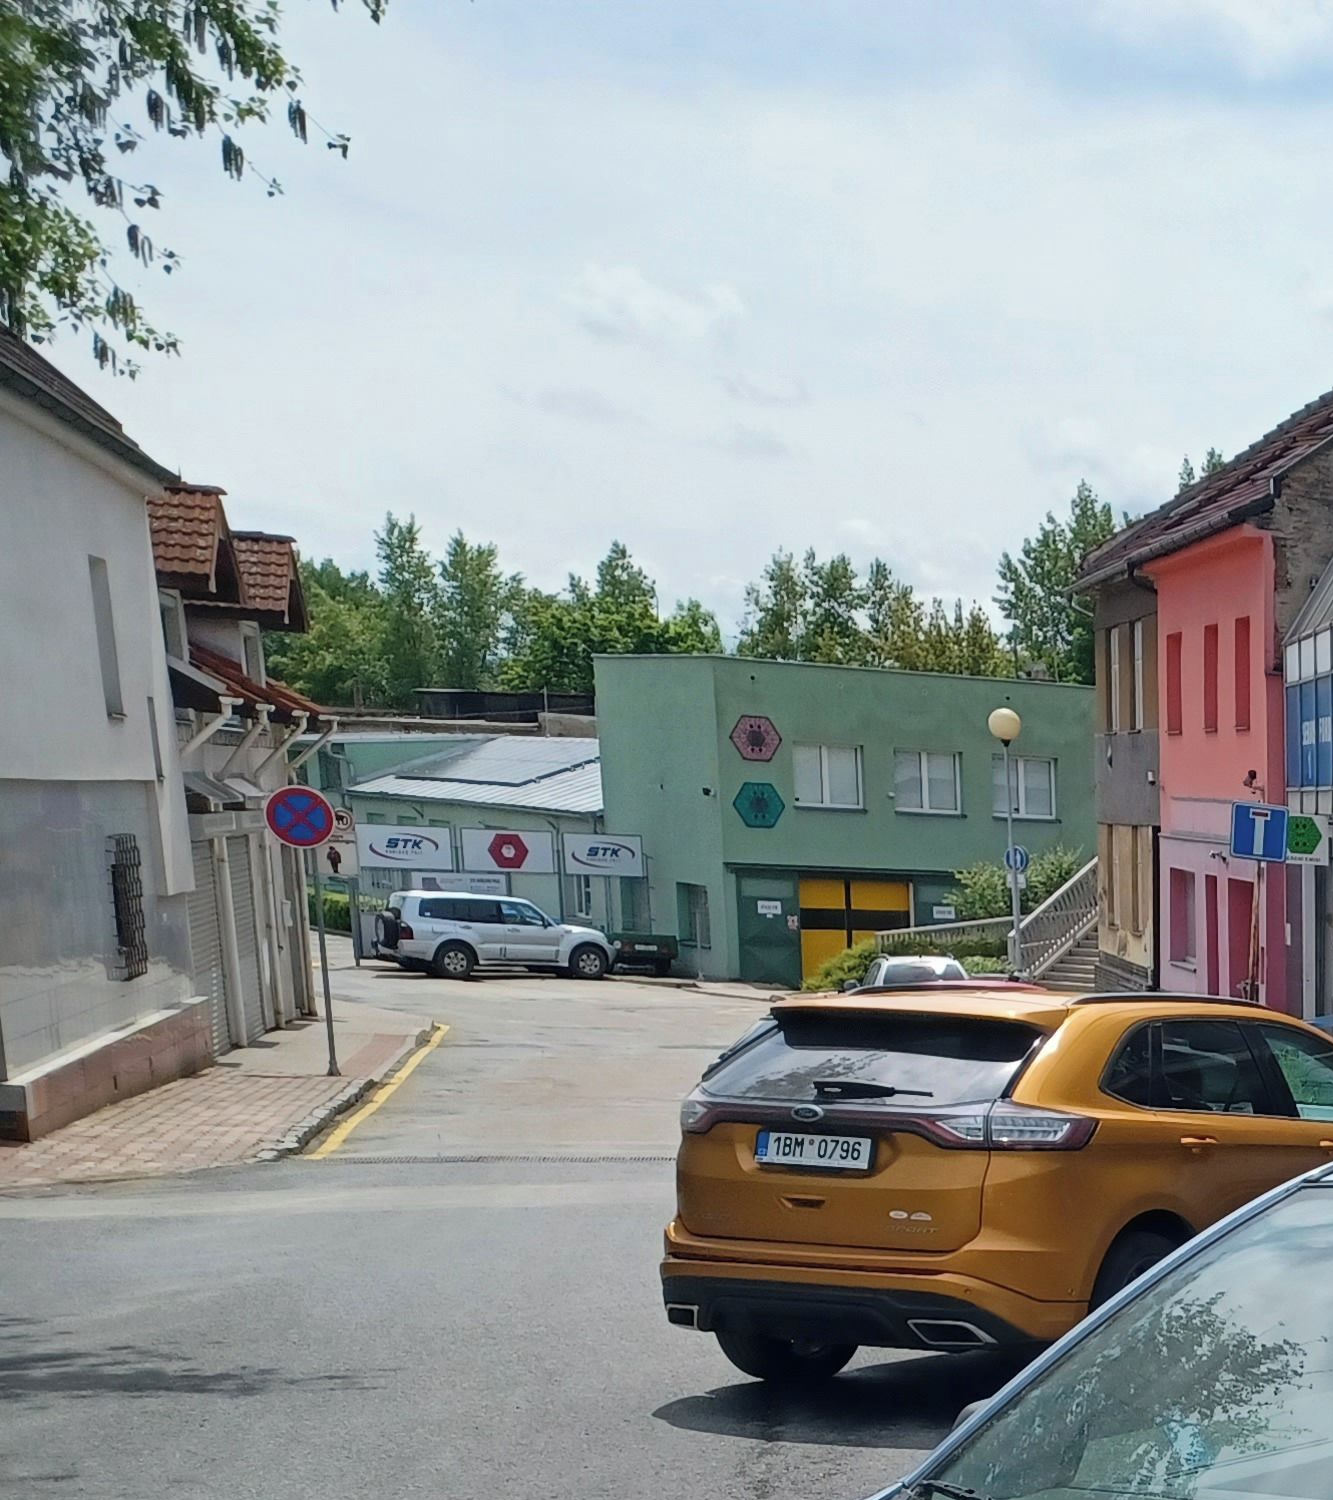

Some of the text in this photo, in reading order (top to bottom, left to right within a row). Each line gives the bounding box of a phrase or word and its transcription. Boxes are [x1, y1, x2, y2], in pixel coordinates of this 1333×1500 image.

[385, 836, 424, 851] STK
[586, 845, 623, 859] STK
[773, 1136, 862, 1161] 1BM 0796
